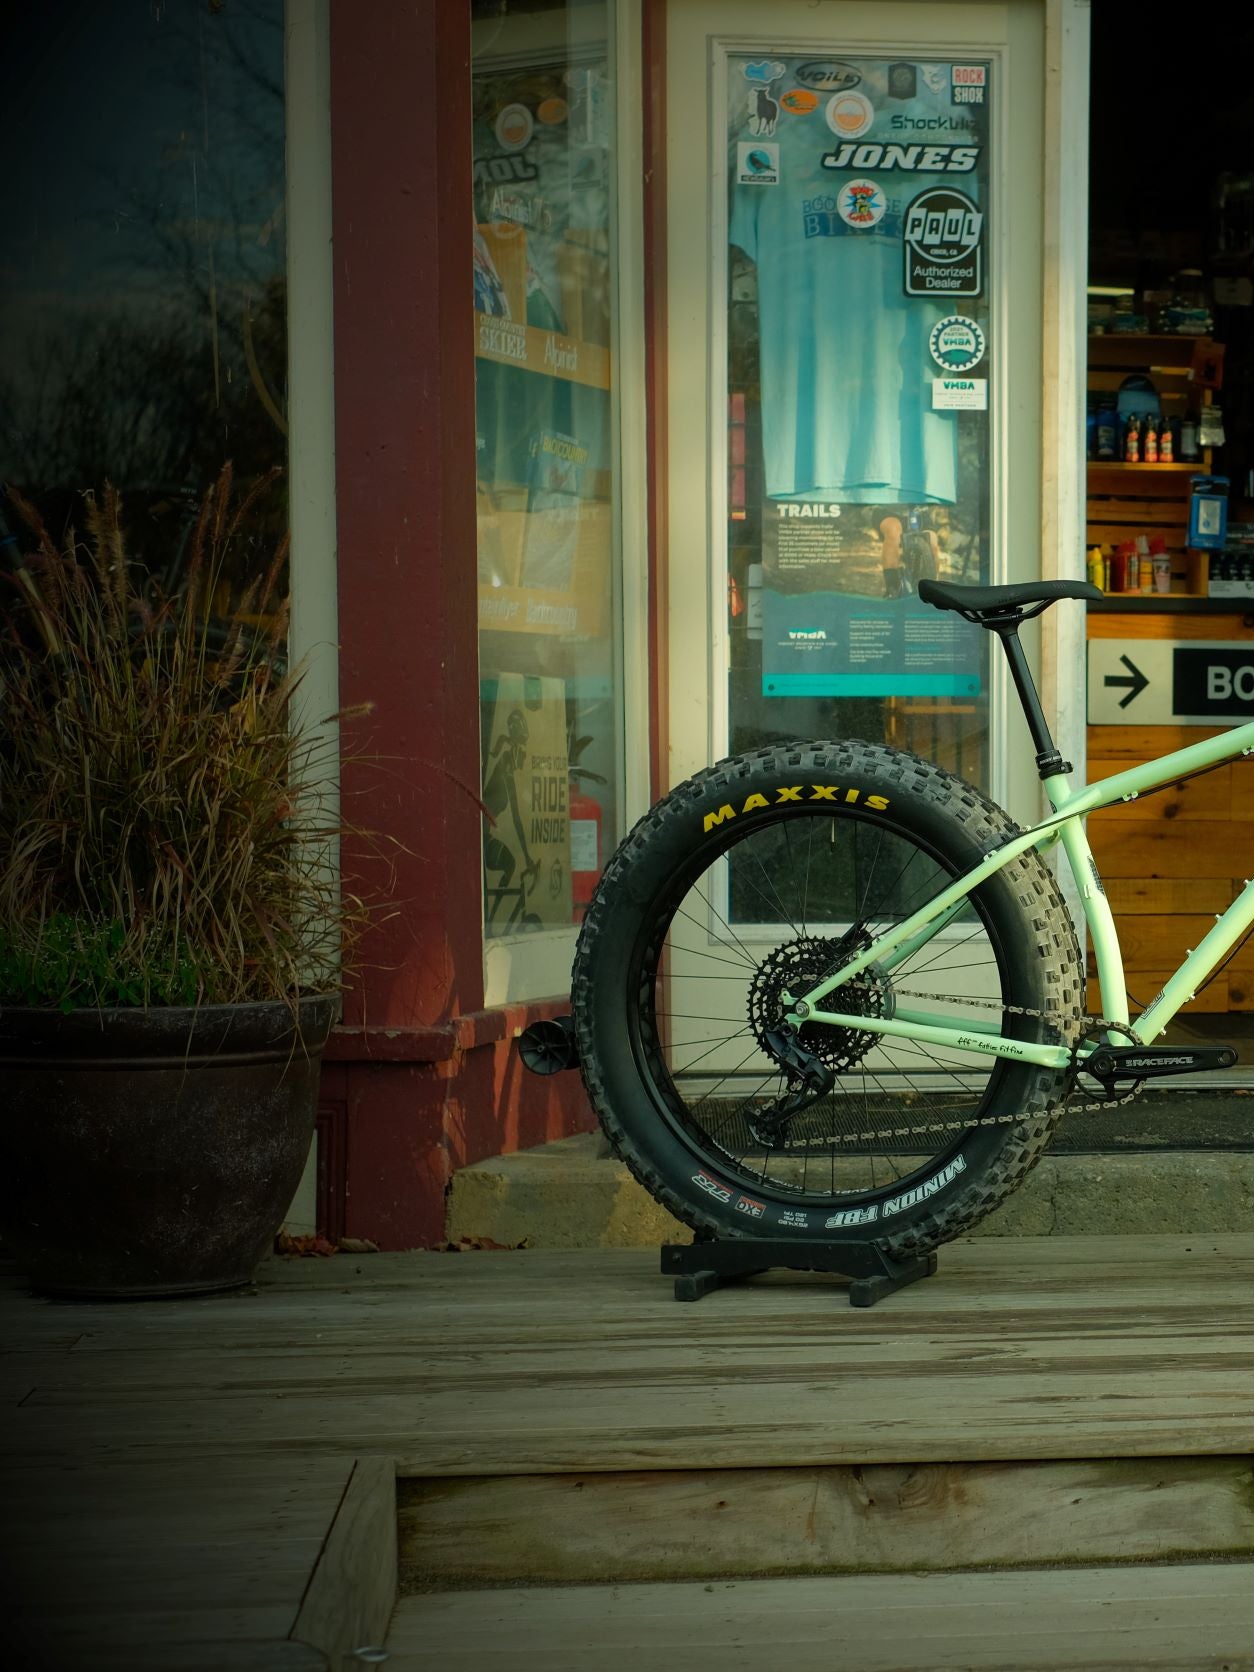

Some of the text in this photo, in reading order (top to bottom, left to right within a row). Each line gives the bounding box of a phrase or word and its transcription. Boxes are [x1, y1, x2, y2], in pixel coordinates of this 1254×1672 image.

[955, 69, 983, 83] ROCK
[954, 86, 984, 103] SHOX
[824, 146, 979, 171] JONES
[908, 214, 978, 238] PAUL
[914, 265, 973, 277] Authorized
[926, 277, 962, 288] Dealer
[480, 327, 528, 360] SKIER
[944, 338, 971, 346] VMBA
[944, 382, 974, 390] VMBA
[777, 504, 841, 518] TRAILS
[531, 777, 567, 812] RIDE
[703, 784, 891, 832] MAXXIS
[531, 818, 566, 844] INSIDE
[1134, 1056, 1194, 1067] RACEFACE
[824, 1153, 967, 1229] MINION FBF
[737, 1201, 762, 1217] EXO
